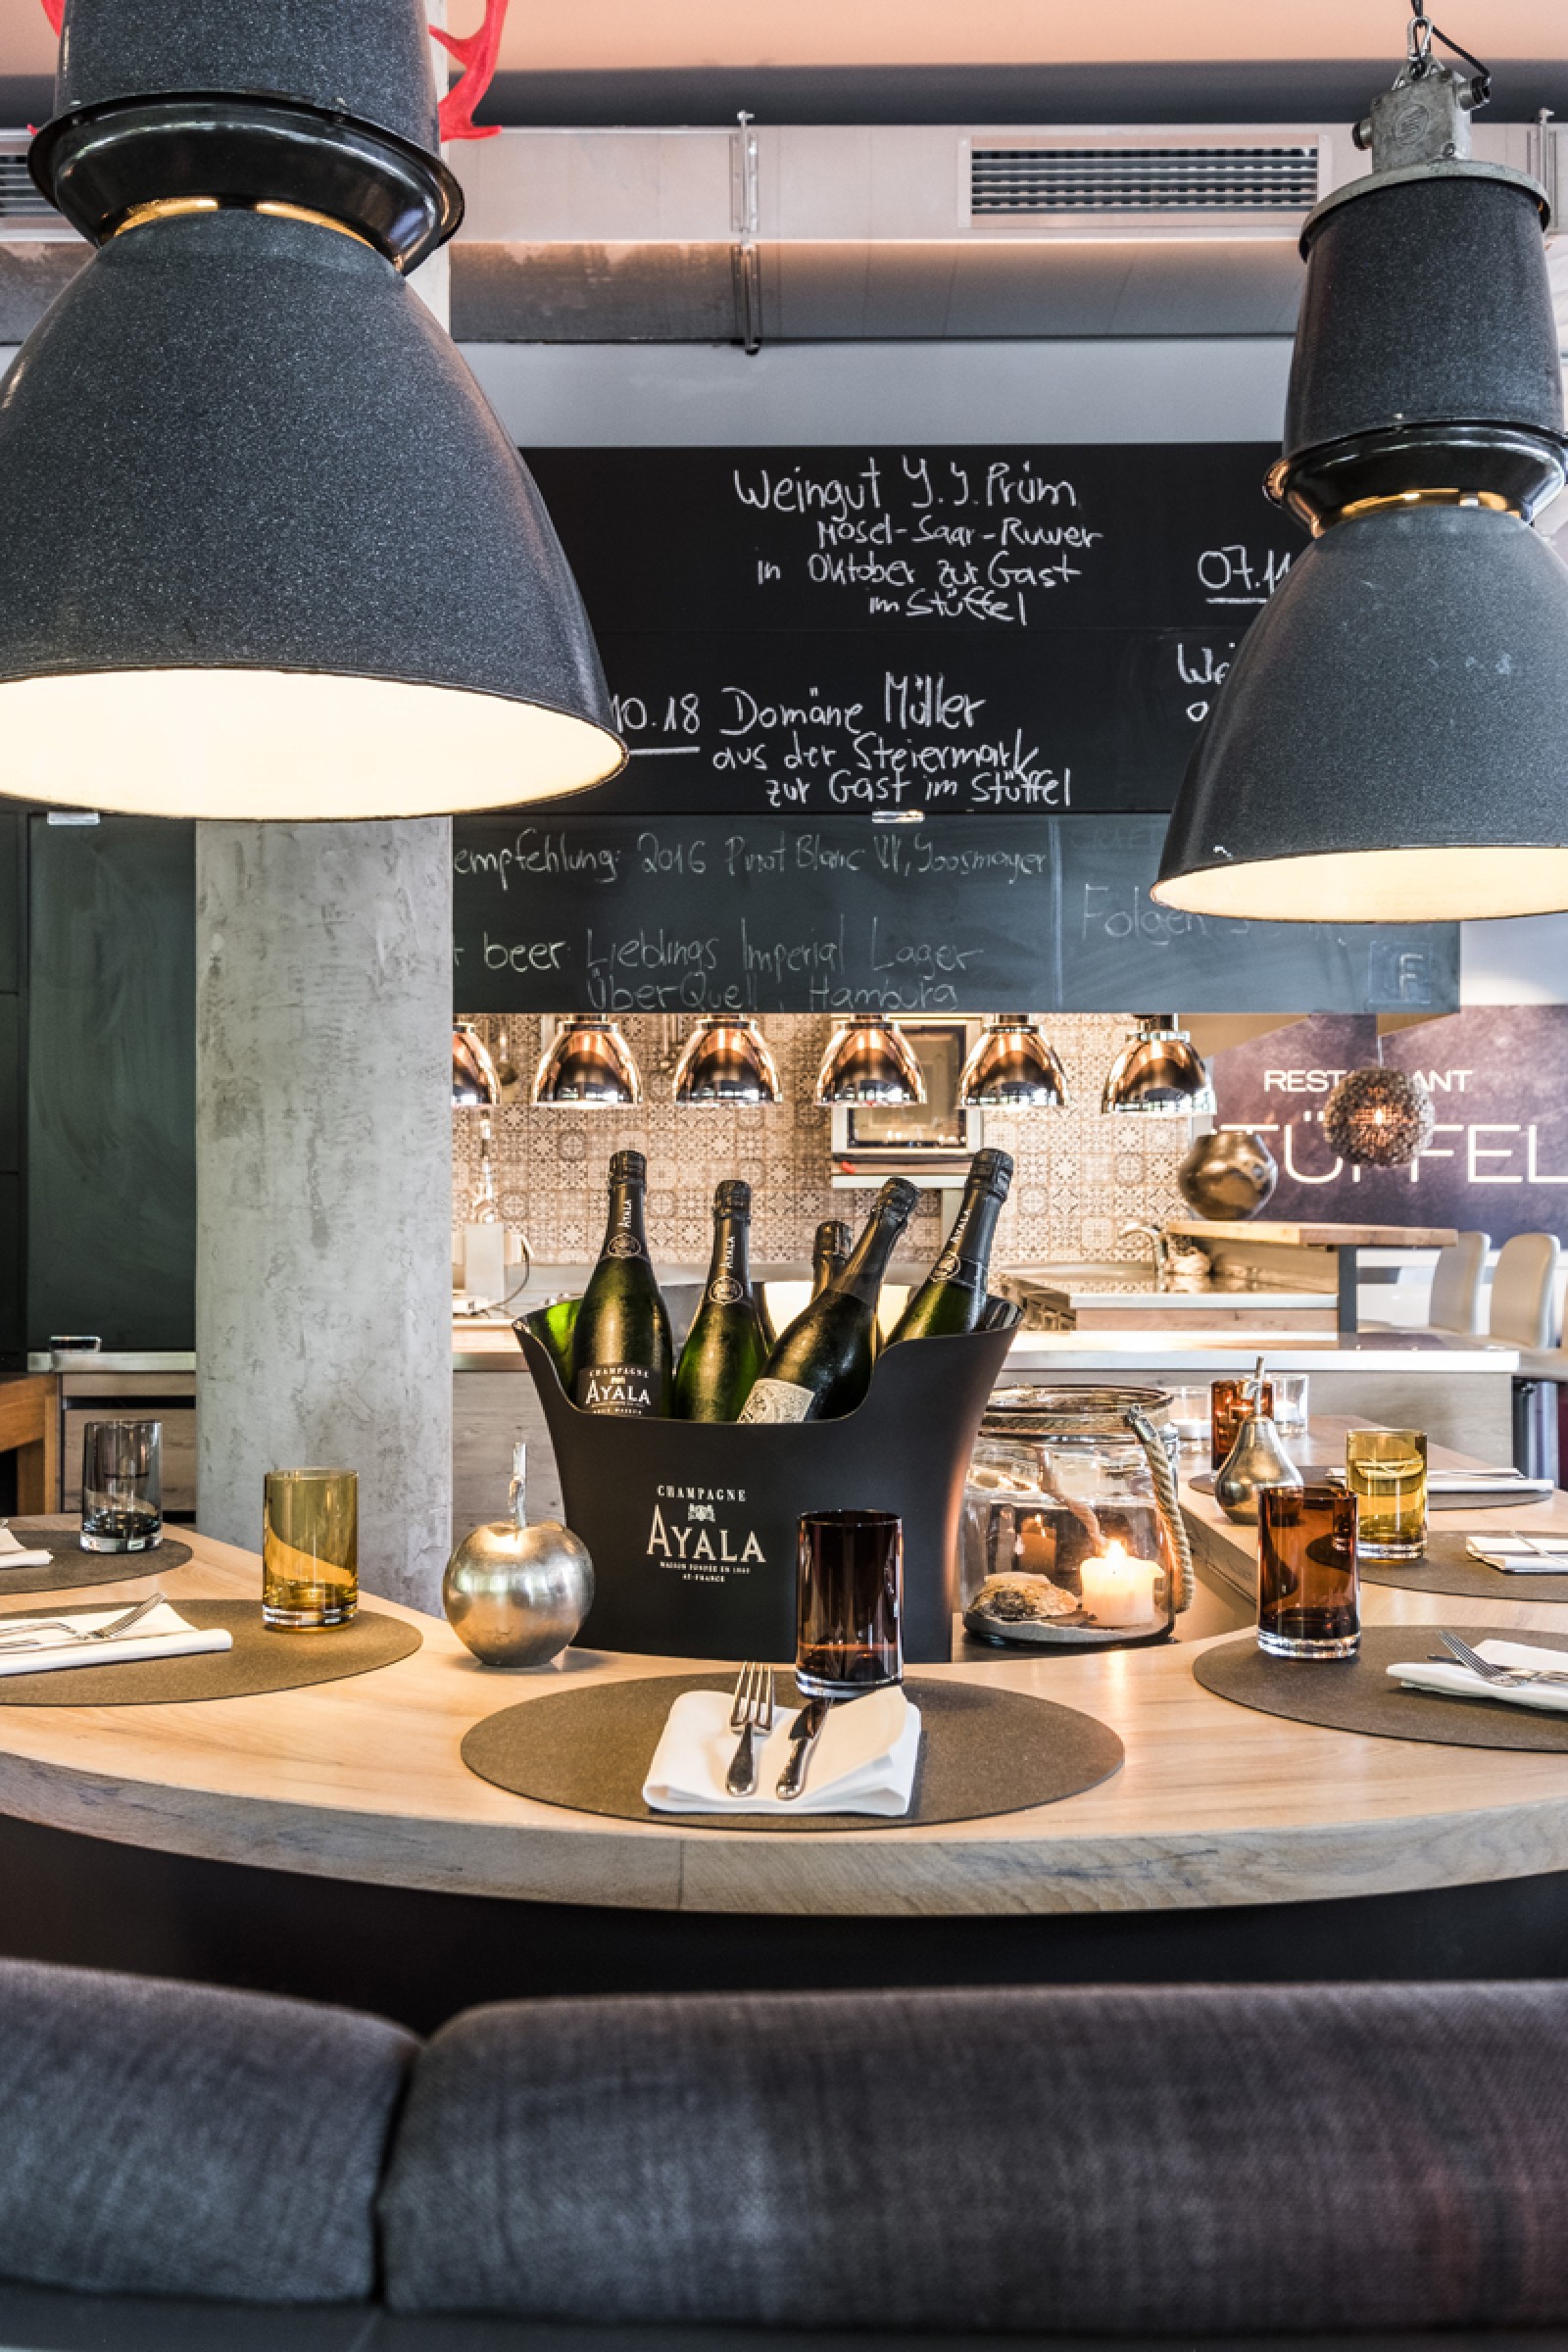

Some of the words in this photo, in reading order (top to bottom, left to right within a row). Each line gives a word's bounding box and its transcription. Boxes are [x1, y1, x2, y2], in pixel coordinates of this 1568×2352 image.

[733, 456, 881, 522] Weingut
[987, 460, 1077, 507] Prüm
[808, 550, 915, 586] Oktober
[937, 559, 978, 589] zur
[988, 550, 1082, 588] Gast
[869, 596, 900, 614] im
[905, 585, 1028, 626] Stüffel
[718, 685, 864, 736] Domäne
[884, 670, 986, 730] Müller
[711, 742, 768, 771] aus
[784, 729, 838, 771] der
[852, 726, 1040, 780] Steiermark
[764, 777, 811, 808] zur
[828, 768, 912, 805] Gast
[921, 773, 958, 801] im
[970, 765, 1071, 808] Stüffel
[637, 832, 708, 875] 2016
[794, 833, 866, 872] Blanc
[869, 915, 985, 981] Lager
[1263, 1069, 1475, 1093] RESTANT
[584, 1378, 653, 1407] AYALA
[657, 1485, 748, 1502] CHAMPAGNE
[646, 1503, 767, 1564] AYALA
